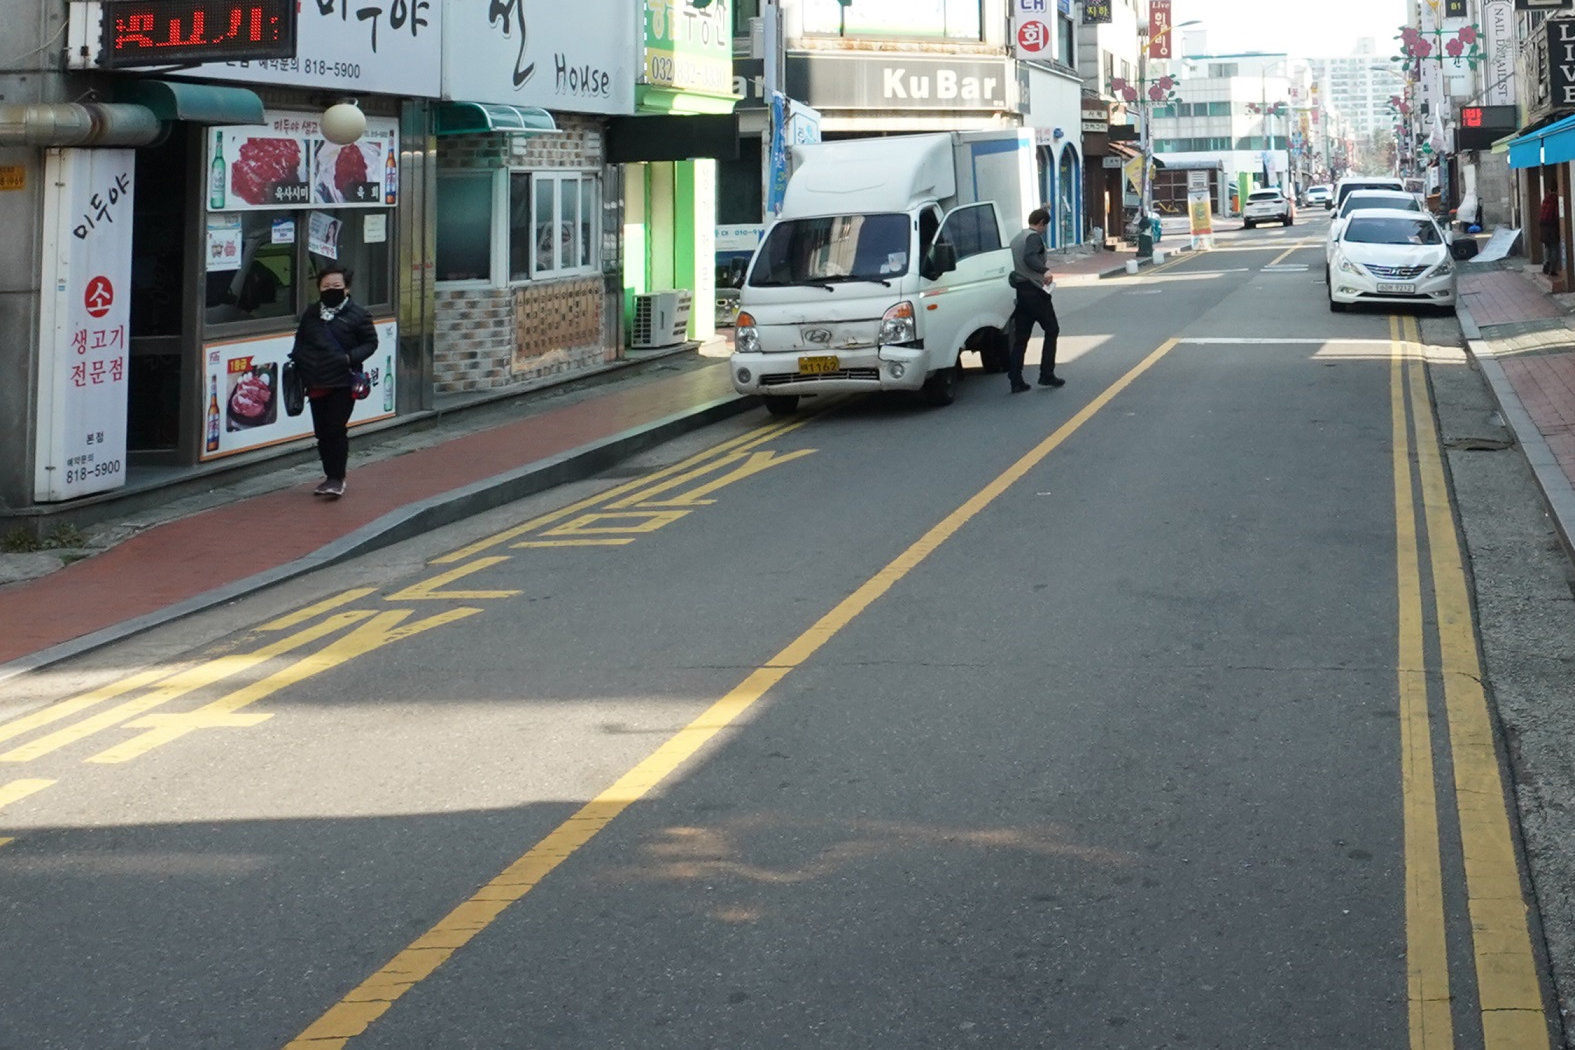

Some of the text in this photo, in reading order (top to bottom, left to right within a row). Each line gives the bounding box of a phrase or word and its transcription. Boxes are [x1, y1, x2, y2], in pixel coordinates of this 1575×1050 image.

[1087, 5, 1108, 17] 지하
[1152, 1, 1170, 9] Live
[1494, 8, 1505, 36] NAIL
[1021, 23, 1046, 50] 회
[304, 59, 361, 79] 818-5900
[554, 53, 609, 94] House
[651, 55, 673, 81] 032
[883, 68, 996, 100] Ku Bar
[274, 119, 300, 132] 미두야
[72, 172, 132, 241] 미두야
[274, 186, 309, 201] 육사시미
[86, 281, 112, 313] 소
[70, 325, 125, 356] 생고기
[70, 356, 124, 388] 전문점
[86, 431, 104, 446] 본점
[66, 453, 94, 468] 예약문의
[66, 460, 120, 484] 818-5900
